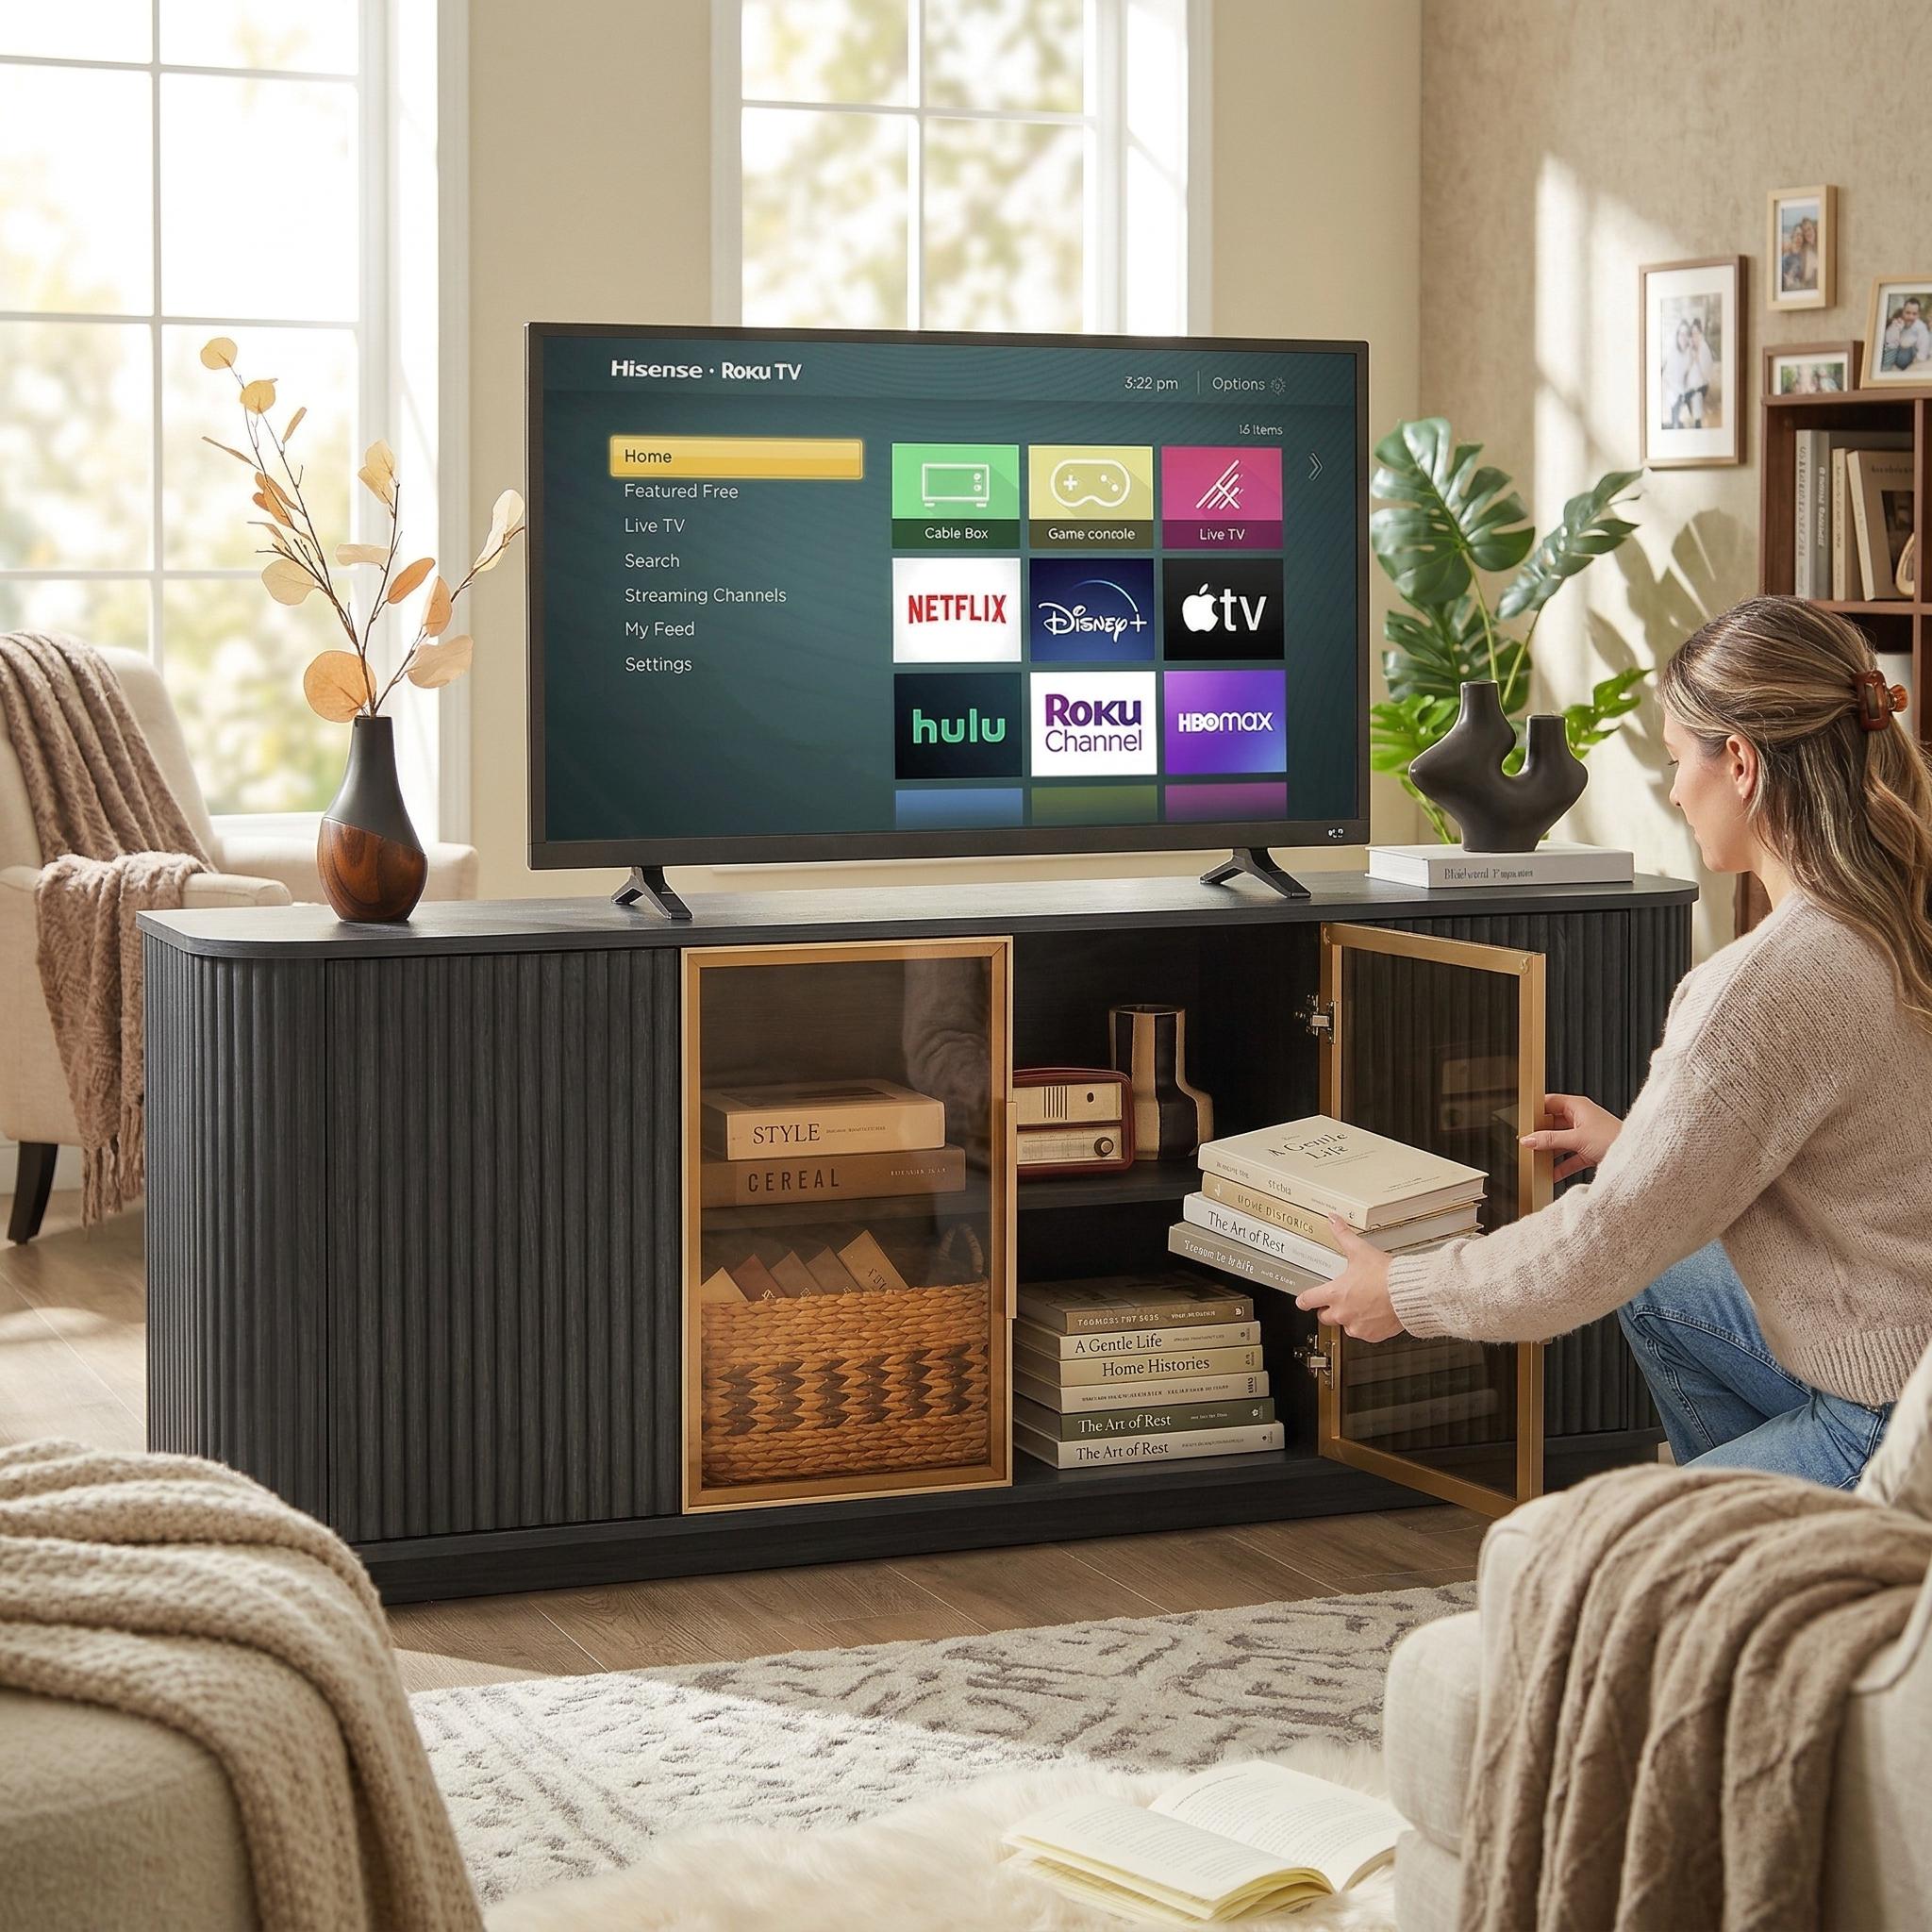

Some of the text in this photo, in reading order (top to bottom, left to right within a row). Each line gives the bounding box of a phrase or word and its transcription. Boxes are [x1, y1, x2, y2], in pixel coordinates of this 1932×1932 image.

[610, 359, 803, 380] Hisense Roku TV
[1124, 376, 1178, 392] 3:22 pm
[1212, 376, 1265, 392] Options
[1253, 425, 1283, 436] Items
[625, 449, 672, 464] Home
[625, 484, 740, 499] Featured Free
[625, 518, 686, 533] Live TV
[924, 526, 989, 541] Cable Box
[1048, 527, 1085, 541] Game
[1199, 528, 1245, 541] Live TV
[625, 553, 680, 569] Search
[625, 588, 787, 605] Streaming Channels
[908, 594, 1007, 625] NETFLIX
[1221, 588, 1268, 632] tv
[625, 622, 695, 640] My Feed
[625, 657, 693, 674] Settings
[1045, 692, 1142, 726] Roku
[912, 708, 1007, 744] hulu
[1045, 729, 1142, 753] Channel
[753, 1124, 821, 1144] STYLE
[748, 1168, 840, 1192] CEREAL
[1208, 1210, 1286, 1254] The Art of Rest
[1074, 1340, 1086, 1354] A
[1090, 1336, 1133, 1353] Gentle
[1136, 1333, 1162, 1350] Life
[1102, 1357, 1210, 1377] Home Histories
[1077, 1413, 1172, 1434] The Art of Rest
[1075, 1446, 1101, 1461] The
[1103, 1445, 1124, 1459] Art
[1126, 1443, 1141, 1457] of
[1142, 1441, 1169, 1456] Rest
